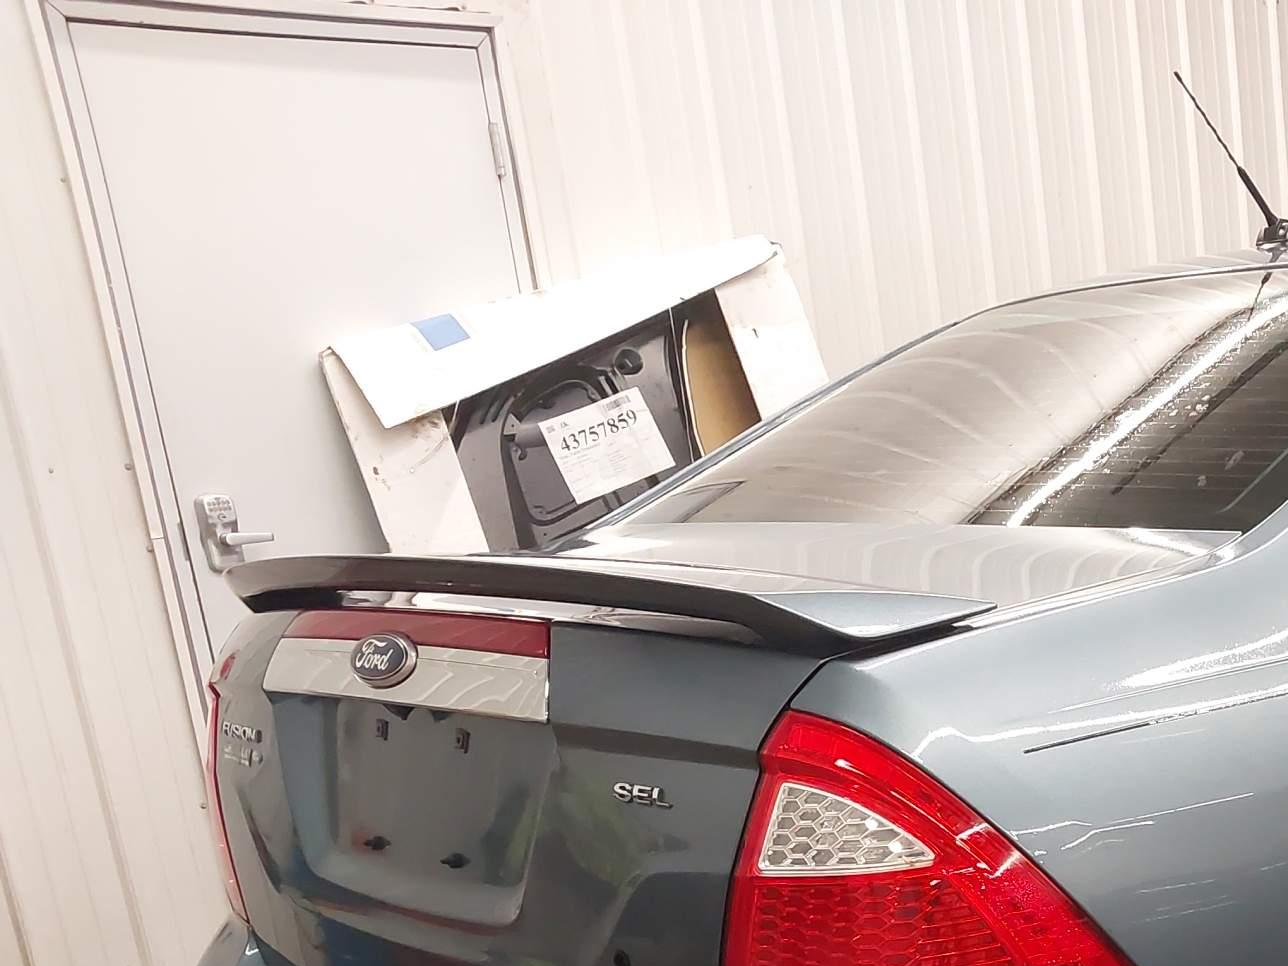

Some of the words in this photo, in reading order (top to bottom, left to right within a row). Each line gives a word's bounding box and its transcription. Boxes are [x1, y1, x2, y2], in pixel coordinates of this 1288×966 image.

[560, 409, 638, 452] 43757859
[355, 638, 395, 671] Ford
[612, 782, 674, 809] SEL
